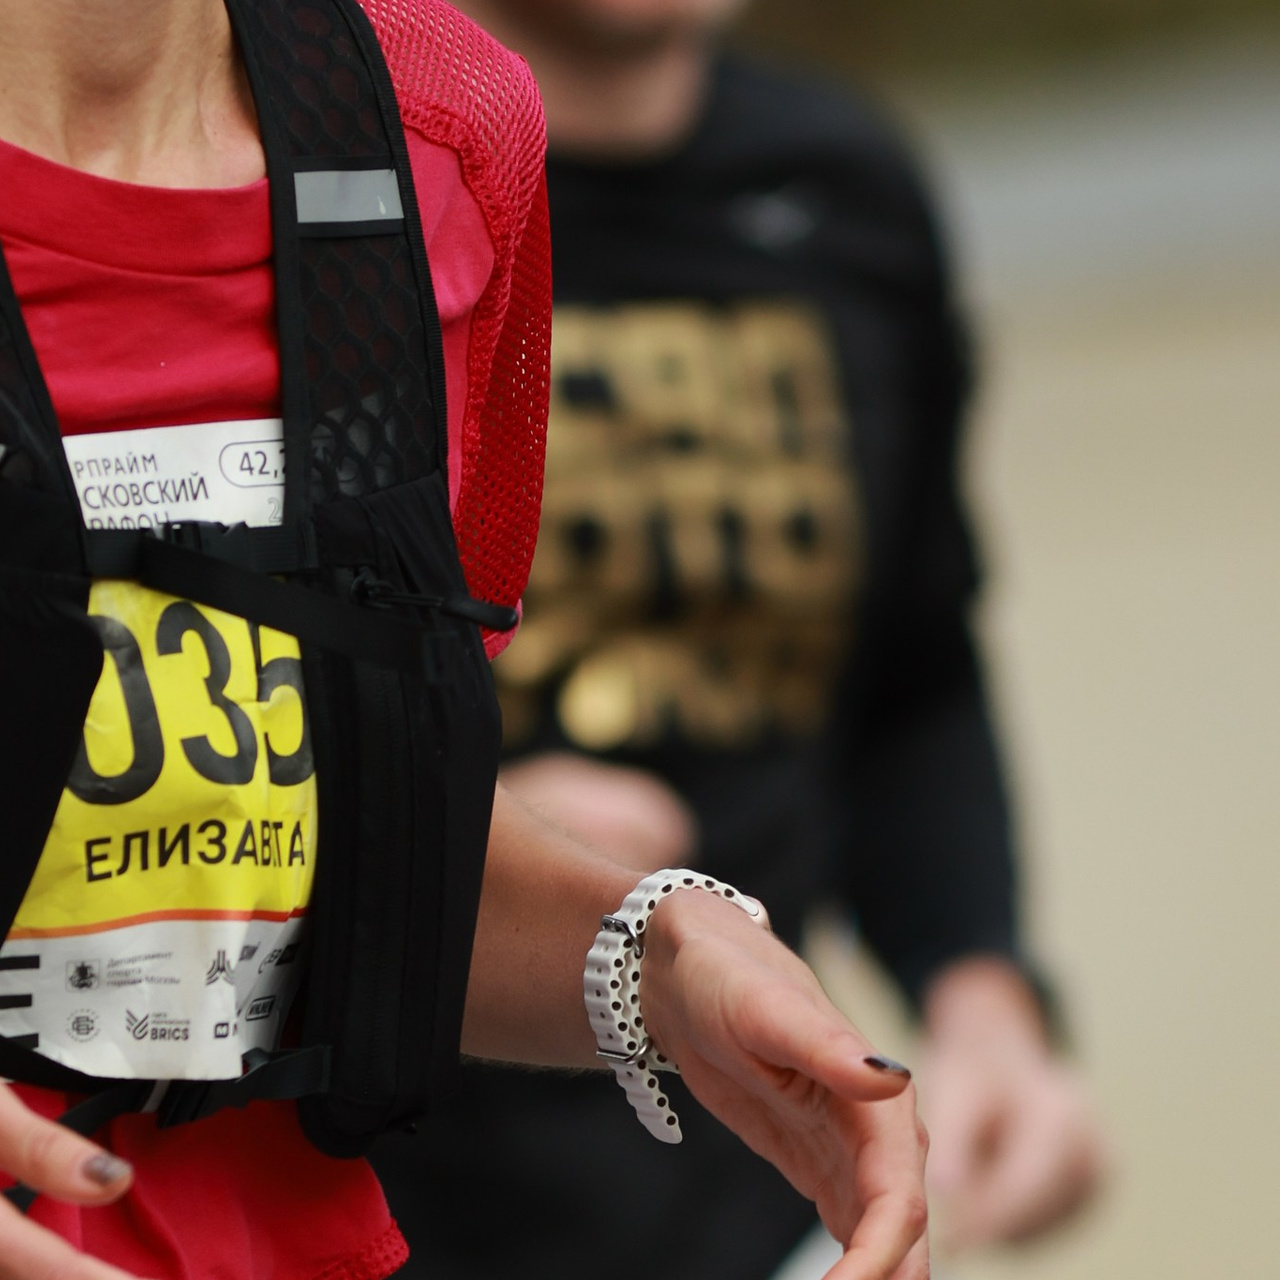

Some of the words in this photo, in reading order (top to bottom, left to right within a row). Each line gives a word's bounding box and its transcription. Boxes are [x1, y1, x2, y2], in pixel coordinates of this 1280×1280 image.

[74, 452, 158, 478] РПРАЙМ
[239, 449, 285, 479] 42,
[82, 471, 210, 510] СКОВСКИЙ
[84, 818, 306, 883] ЕЛИЗАВТА
[150, 1027, 190, 1040] BRICS
